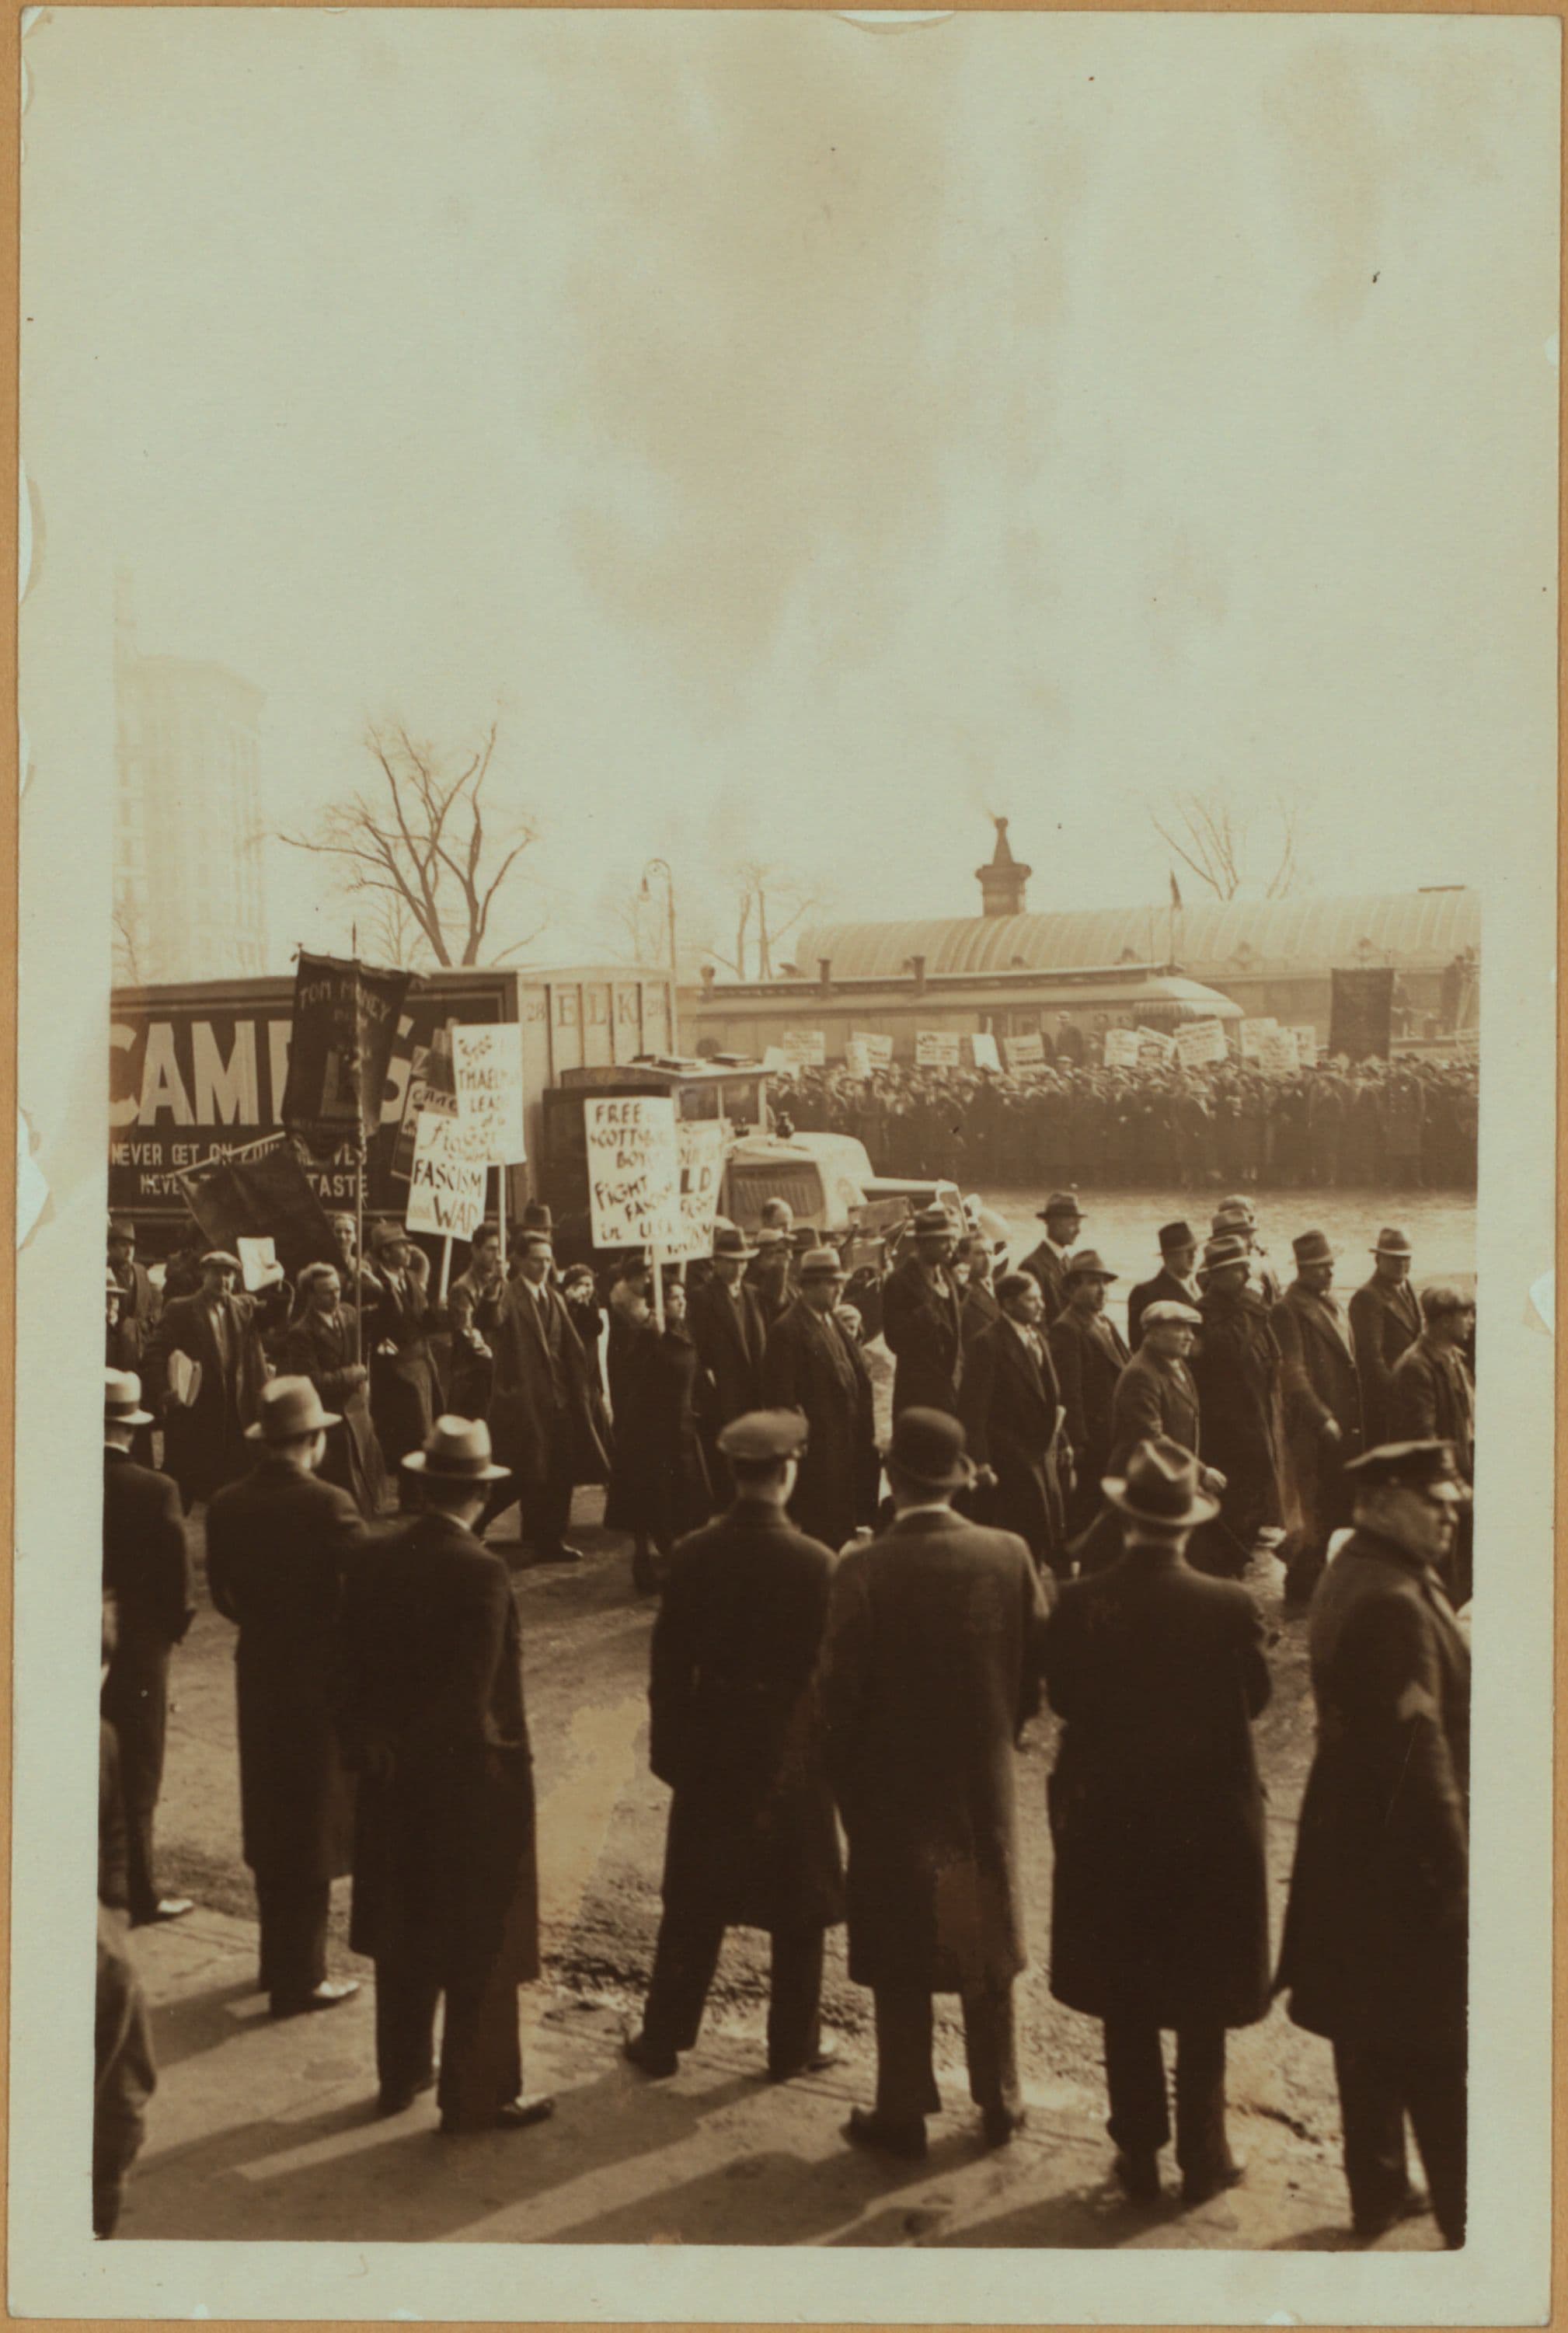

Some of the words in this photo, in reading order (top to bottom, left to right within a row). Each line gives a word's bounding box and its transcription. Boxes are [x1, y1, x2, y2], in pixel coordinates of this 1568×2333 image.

[595, 1101, 642, 1125] FREE
[111, 1142, 162, 1166] NEVER
[172, 1142, 200, 1166] GET
[305, 1173, 368, 1198] TASTE
[413, 1158, 483, 1199] FASCISM
[594, 1173, 648, 1212] FIGHT
